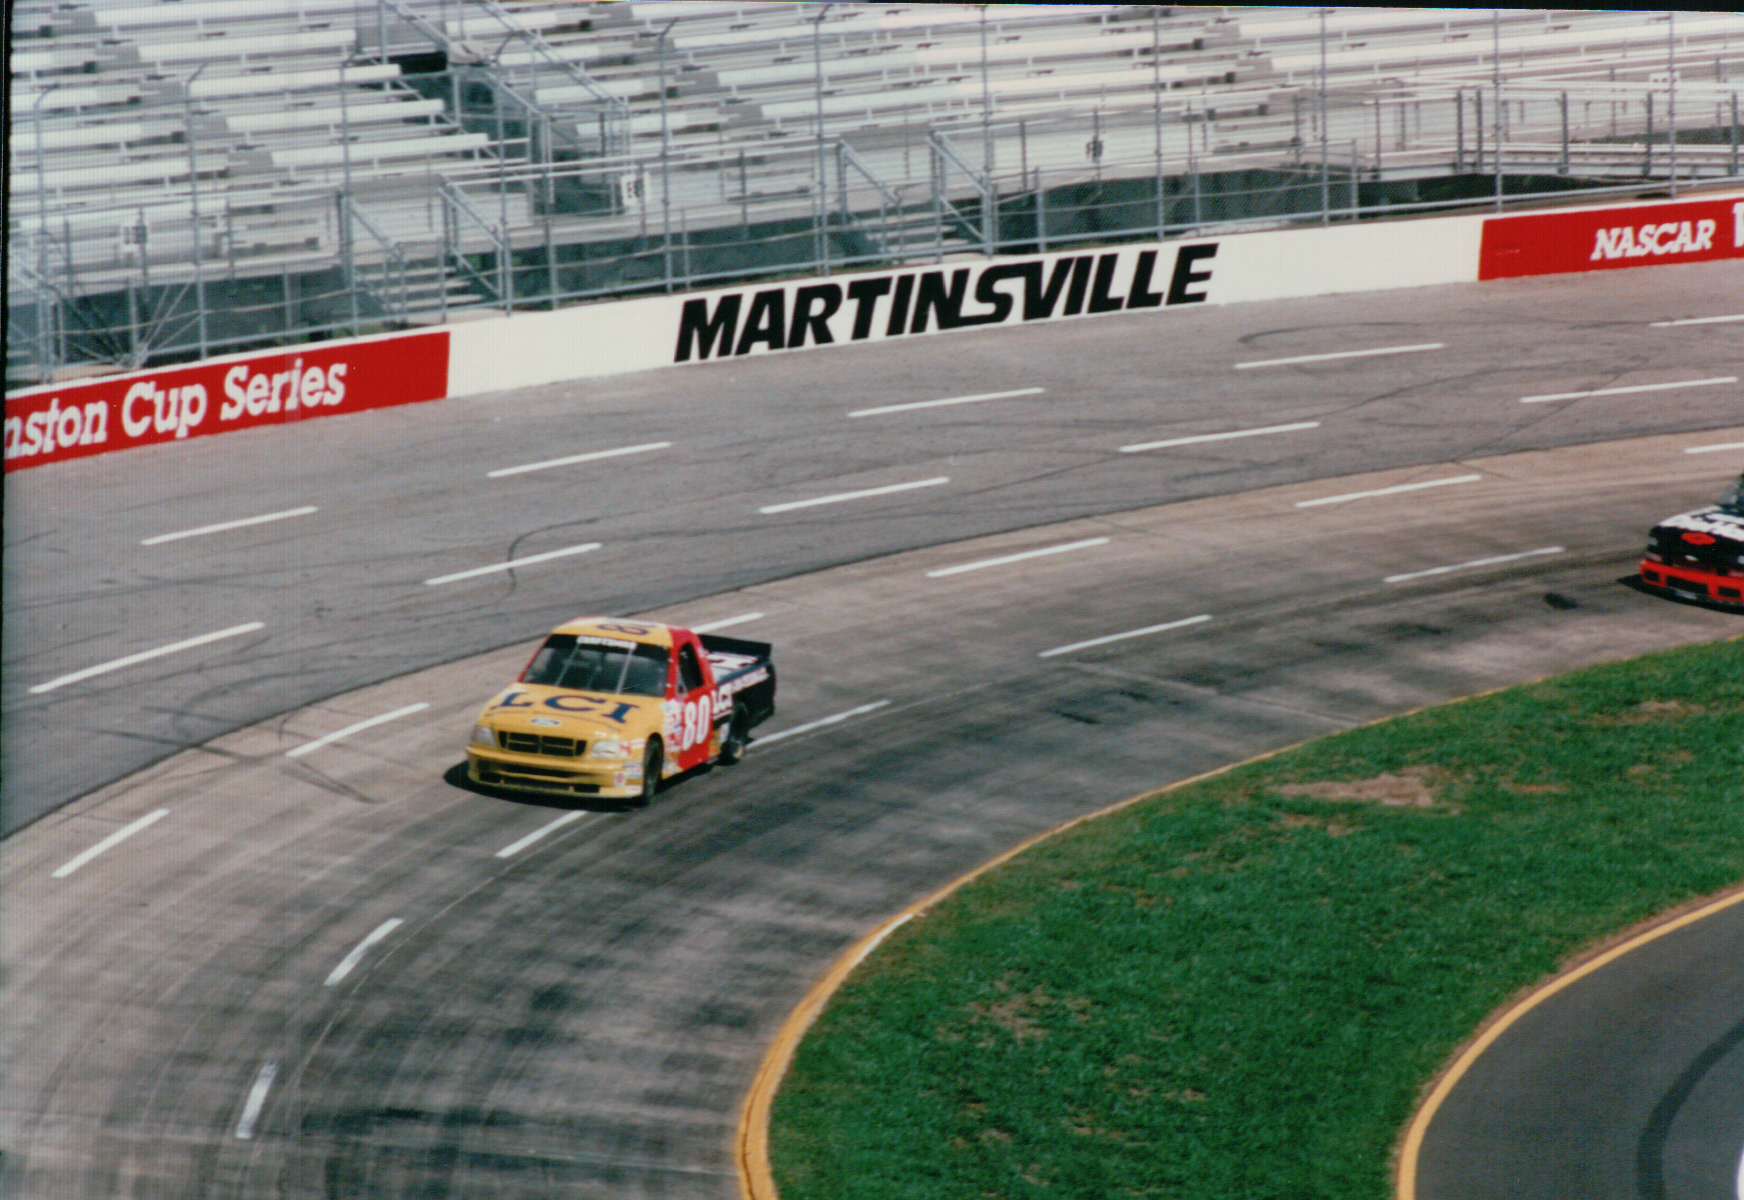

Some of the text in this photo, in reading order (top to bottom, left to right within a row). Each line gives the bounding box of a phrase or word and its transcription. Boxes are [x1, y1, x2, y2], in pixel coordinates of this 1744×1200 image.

[1589, 219, 1717, 262] NASCAR
[673, 242, 1220, 364] MARTINSVILLE
[121, 380, 208, 438] Cup
[219, 357, 348, 421] Series
[489, 691, 641, 724] LCI
[682, 694, 710, 751] 80
